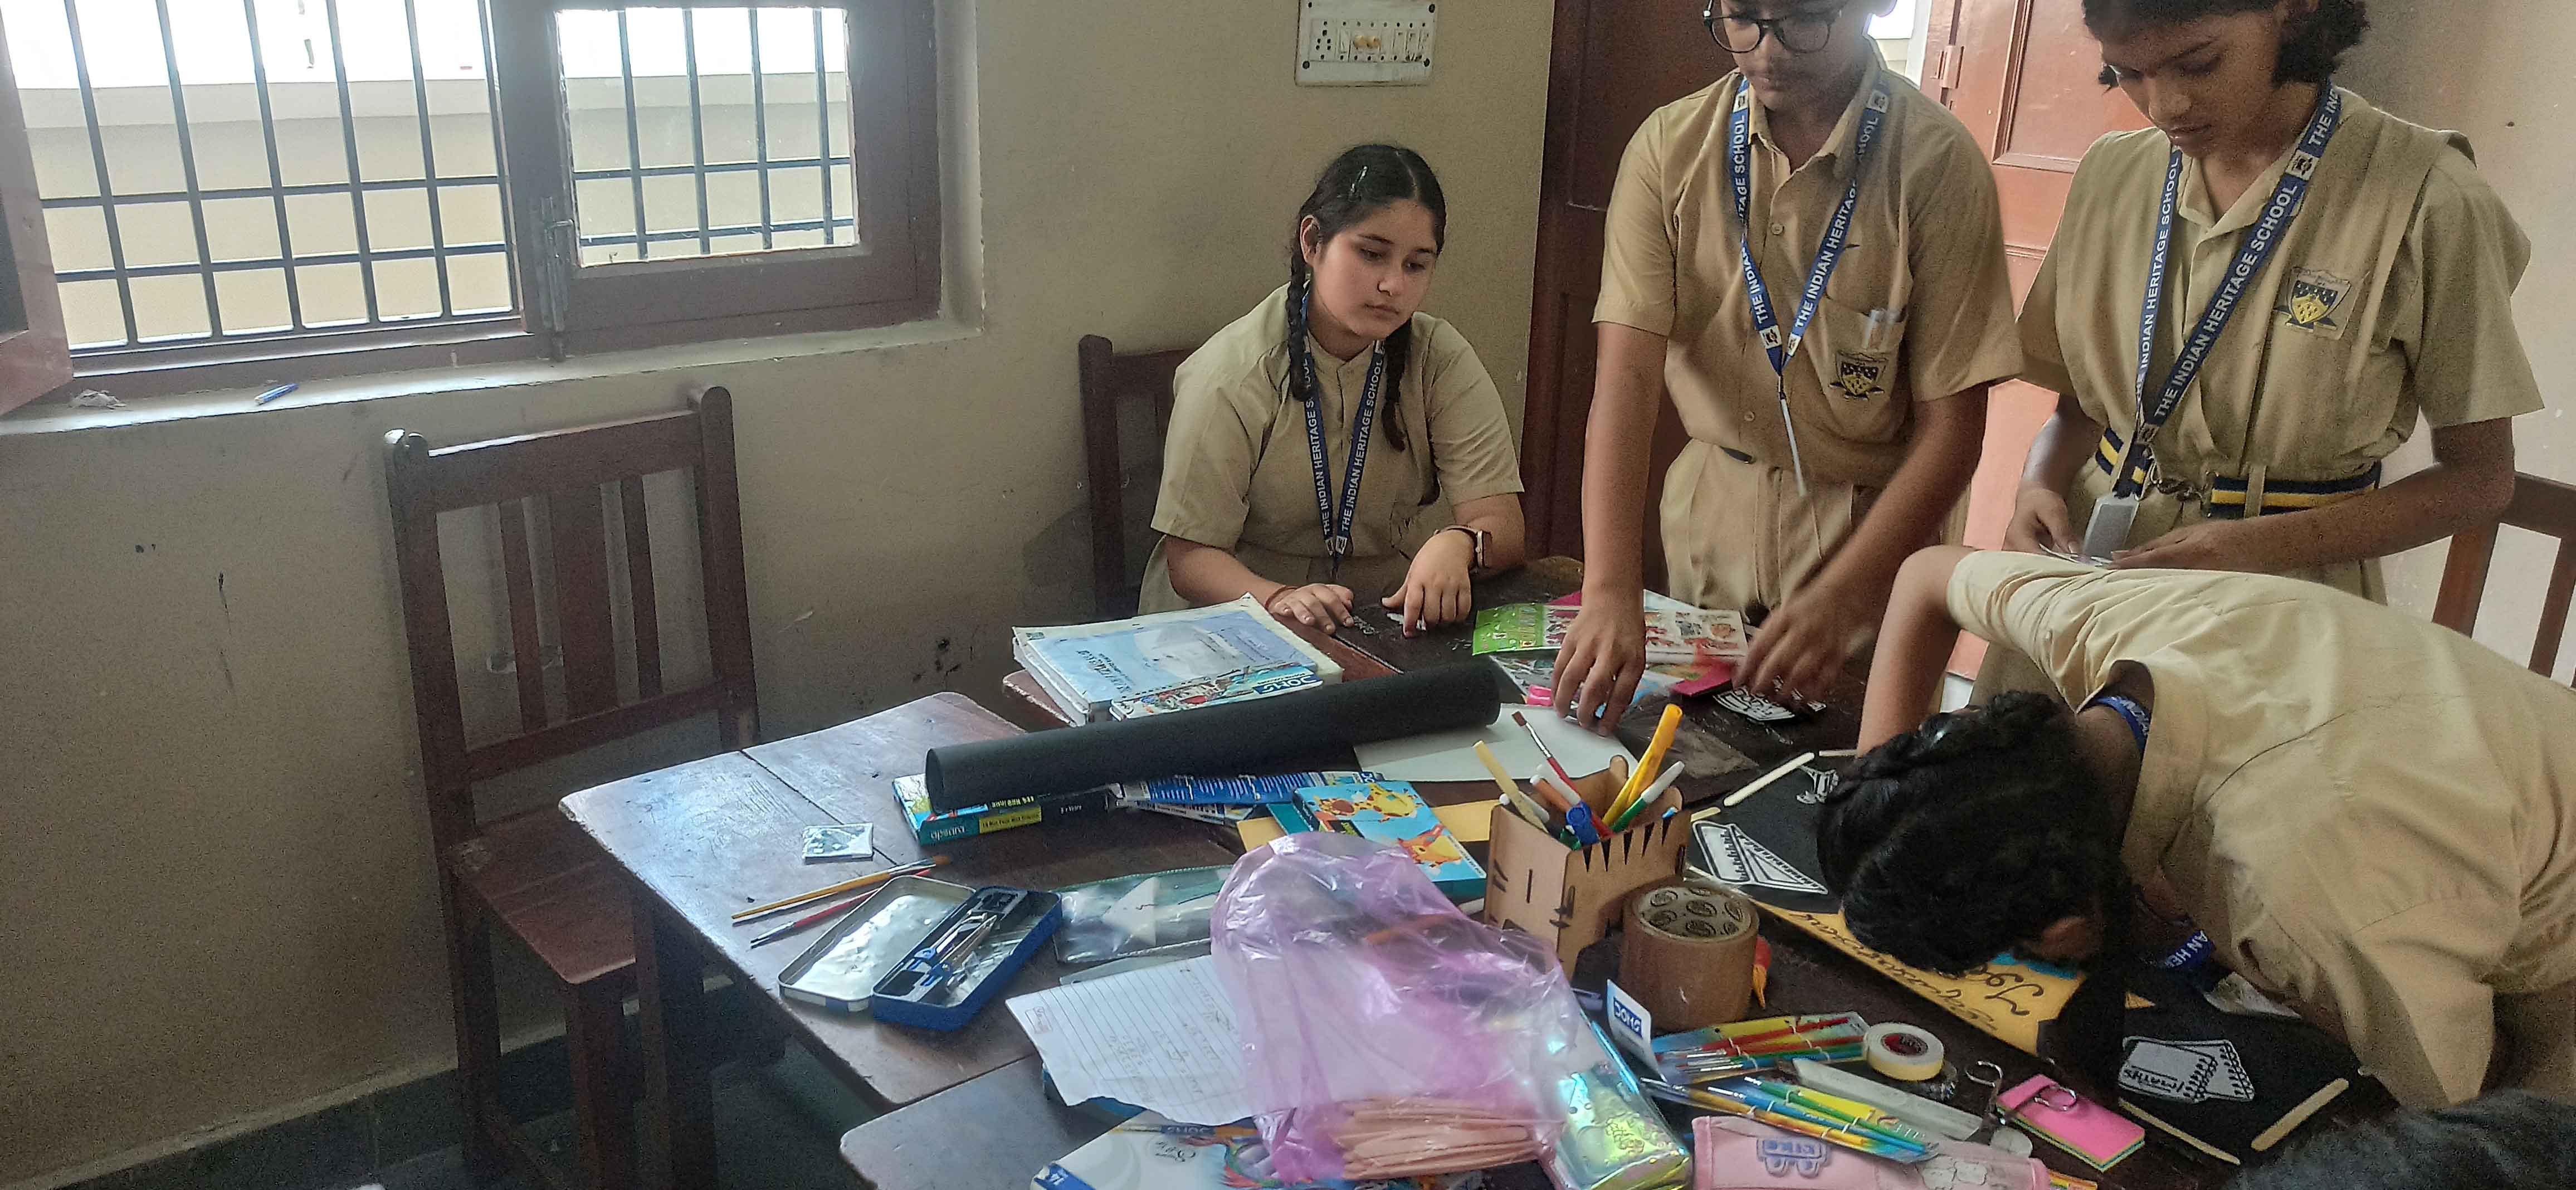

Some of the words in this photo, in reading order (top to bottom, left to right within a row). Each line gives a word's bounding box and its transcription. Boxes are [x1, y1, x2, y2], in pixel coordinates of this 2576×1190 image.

[1733, 115, 1746, 174] SCHOOL
[2308, 114, 2332, 145] THE
[2161, 158, 2179, 225] SCHOOL
[1795, 300, 1813, 328] THE
[1806, 251, 1835, 299] INDIAN
[1826, 181, 1856, 249] HERITAG
[2146, 229, 2168, 309] HERITAGE
[1752, 294, 1769, 324] THE
[2154, 387, 2178, 417] THE
[2172, 334, 2211, 387] INDIAN
[2203, 252, 2258, 333] HERITAGE
[2250, 185, 2297, 252] SCHOOL
[2140, 314, 2154, 369] INDIAN
[1366, 360, 1383, 407] SCHOOL
[1306, 409, 1323, 469] HERITAGE
[1354, 409, 1373, 467] HERITAGE
[1315, 471, 1329, 510] INDIAN
[1345, 468, 1361, 509] INDIAN
[1341, 508, 1352, 531] THE
